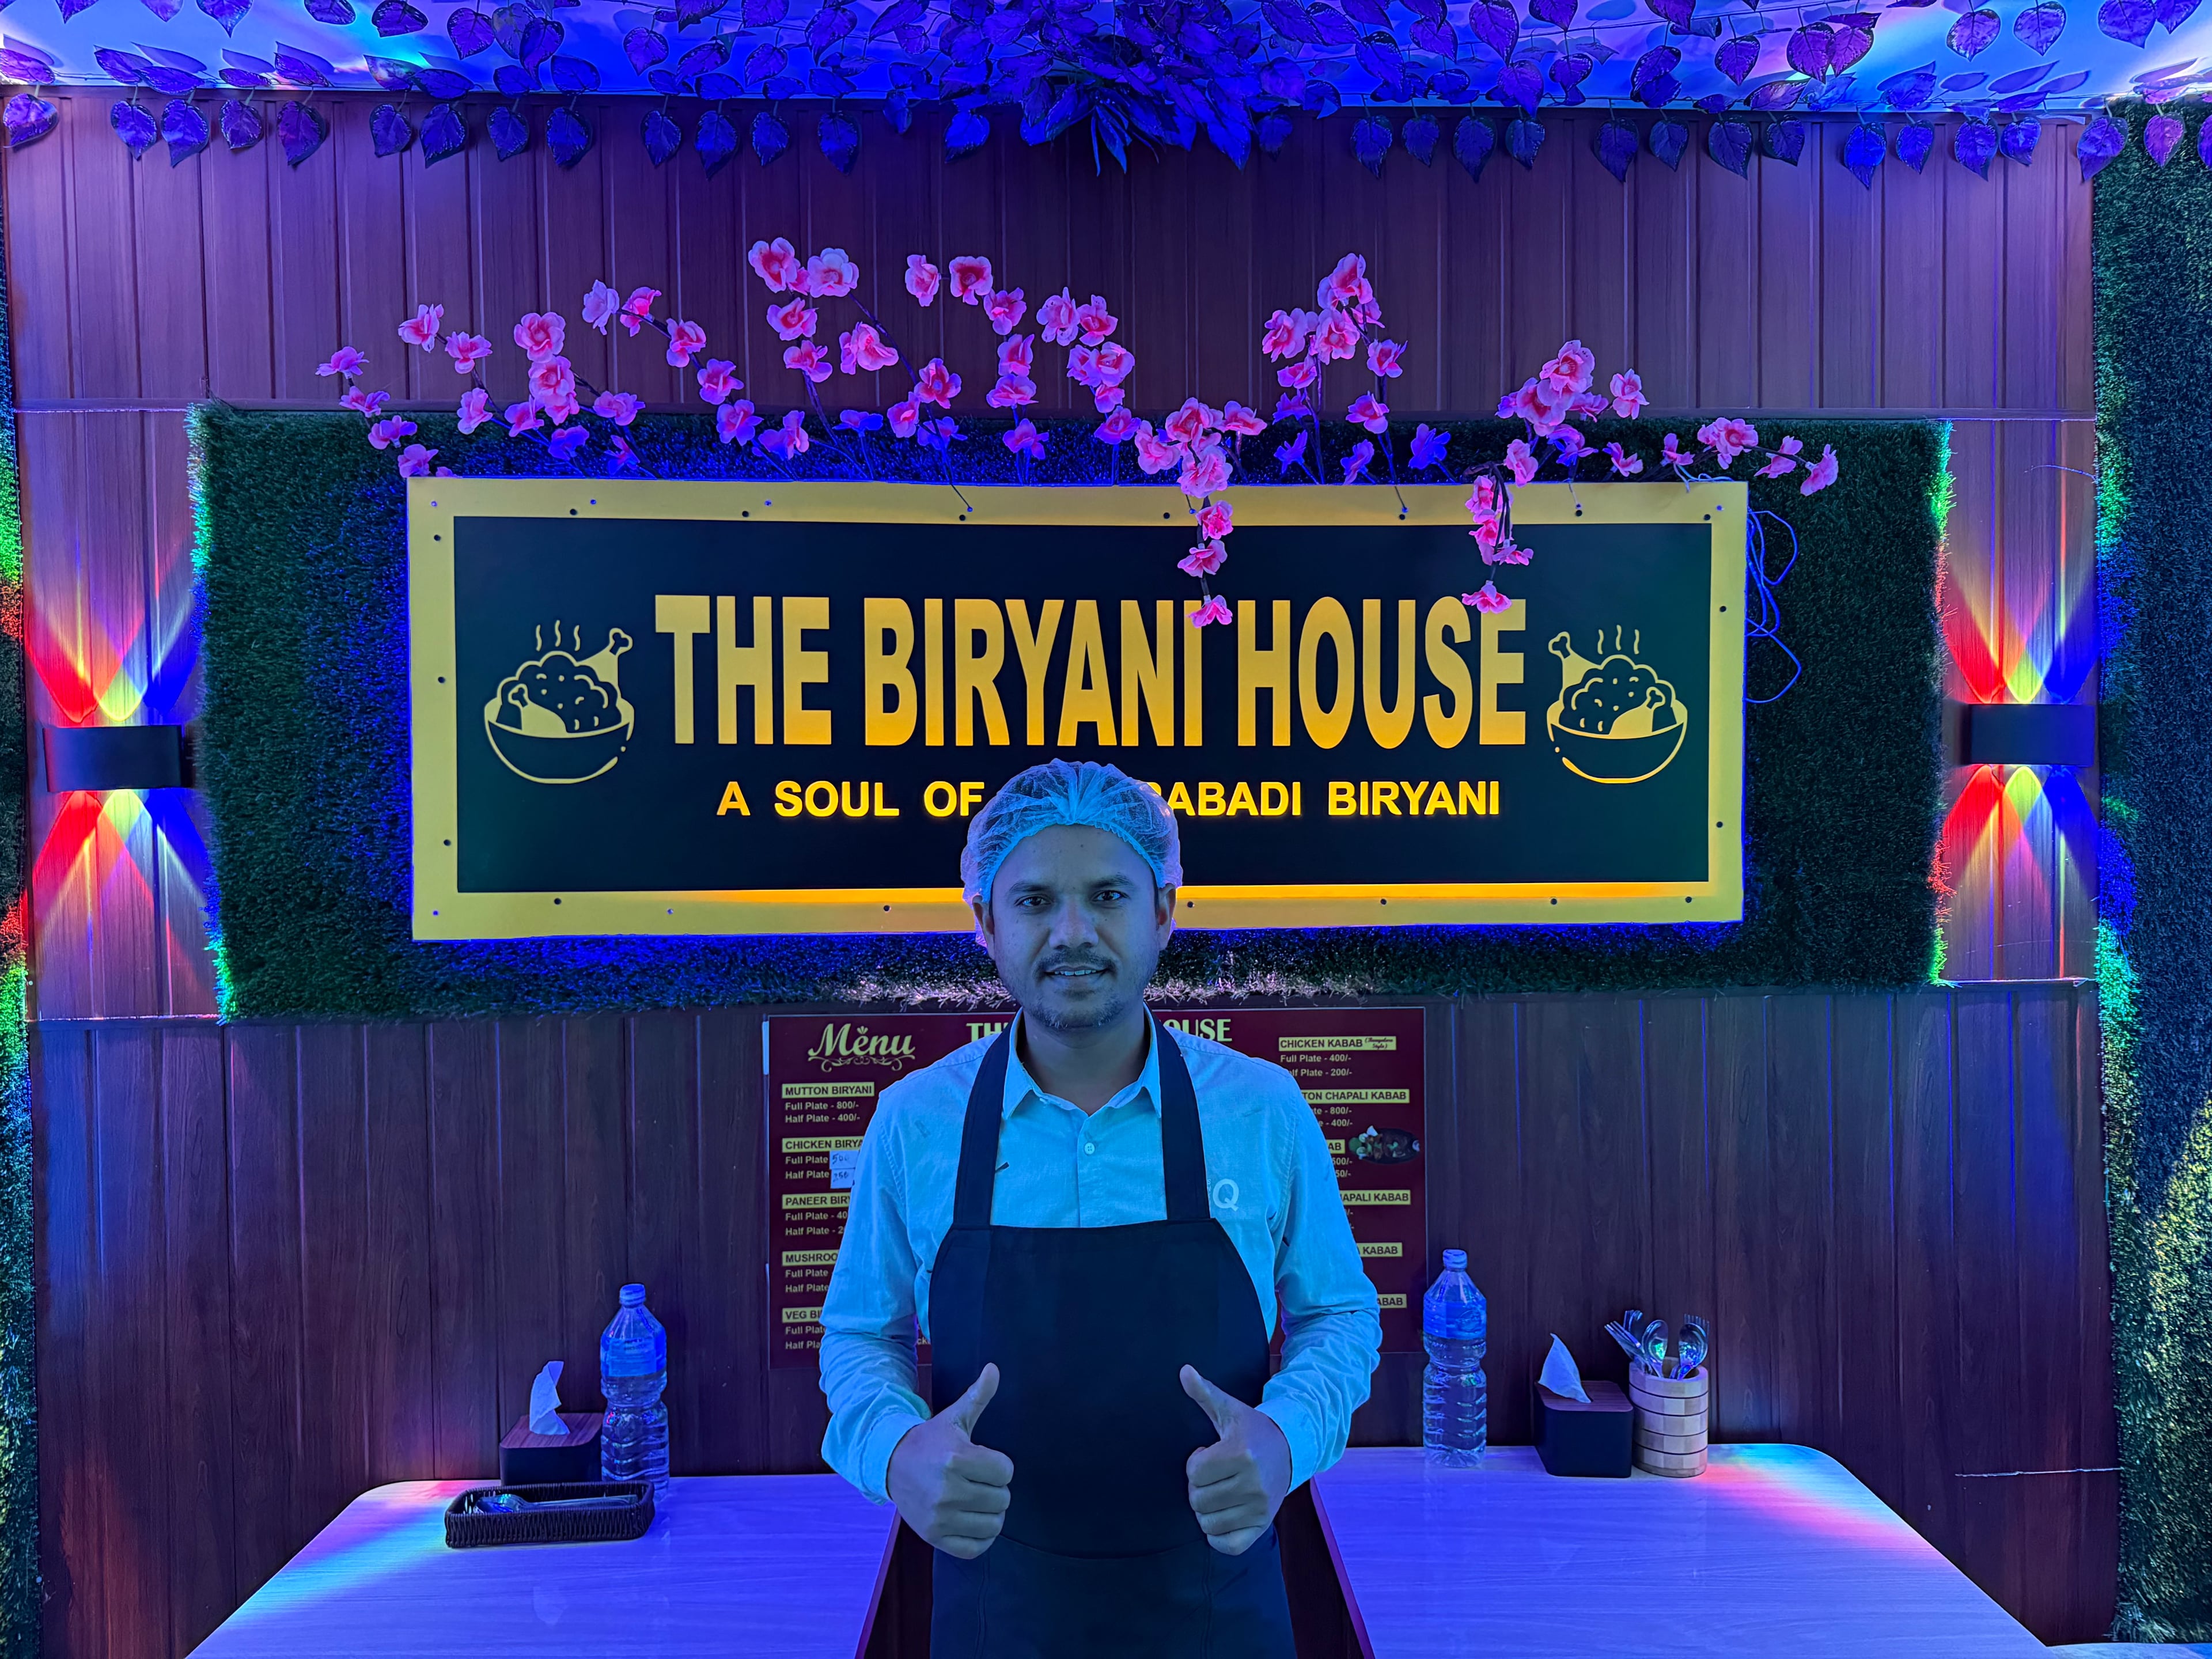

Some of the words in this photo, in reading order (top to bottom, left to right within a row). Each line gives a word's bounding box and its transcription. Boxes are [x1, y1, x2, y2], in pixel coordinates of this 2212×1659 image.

[655, 595, 831, 745] THE
[864, 597, 1203, 747] BIRYANI
[1237, 596, 1527, 749] HOUSE
[717, 781, 751, 816] A
[774, 781, 900, 817] SOUL
[923, 781, 984, 817] OF
[1147, 781, 1301, 816] ABADI
[1328, 781, 1499, 816] BIRYANI
[966, 1022, 1009, 1042] TH
[808, 1023, 915, 1056] Menu
[1280, 1039, 1325, 1048] CHICKEN
[1328, 1039, 1363, 1047] KABAB
[1280, 1055, 1296, 1063] Full
[1300, 1054, 1321, 1062] Plate
[1330, 1054, 1351, 1062] 400/-
[1301, 1069, 1323, 1077] Plate
[1331, 1068, 1353, 1076] 200/-
[785, 1086, 828, 1096] MUTTON
[832, 1085, 872, 1094] BIRYANI
[1325, 1091, 1368, 1100] CHAPALI
[1371, 1091, 1406, 1100] KABAB
[785, 1102, 803, 1110] Full
[805, 1101, 828, 1109] Plate
[836, 1101, 859, 1109] 800/-
[1330, 1107, 1352, 1115] 800/-
[785, 1115, 804, 1123] Half
[806, 1114, 829, 1122] Plate
[838, 1113, 860, 1122] 400/-
[1331, 1119, 1353, 1127] 400/-
[785, 1140, 832, 1150] CHICKEN
[785, 1156, 803, 1164] Full
[805, 1156, 828, 1164] Plate
[785, 1171, 804, 1179] Half
[806, 1170, 830, 1179] Plate
[786, 1196, 827, 1206] PANEER
[1340, 1193, 1371, 1202] APALI
[1374, 1192, 1409, 1202] KABAB
[785, 1212, 803, 1221] Full
[805, 1211, 828, 1220] Plate
[785, 1227, 804, 1236] Half
[806, 1226, 830, 1234] Plate
[1362, 1246, 1398, 1255] KABAB
[785, 1269, 803, 1278] Full
[805, 1268, 828, 1277] Plate
[785, 1284, 804, 1293] Half
[806, 1283, 829, 1292] Plate
[785, 1310, 807, 1320] VEG
[785, 1326, 803, 1335] Full
[785, 1341, 804, 1350] Half
